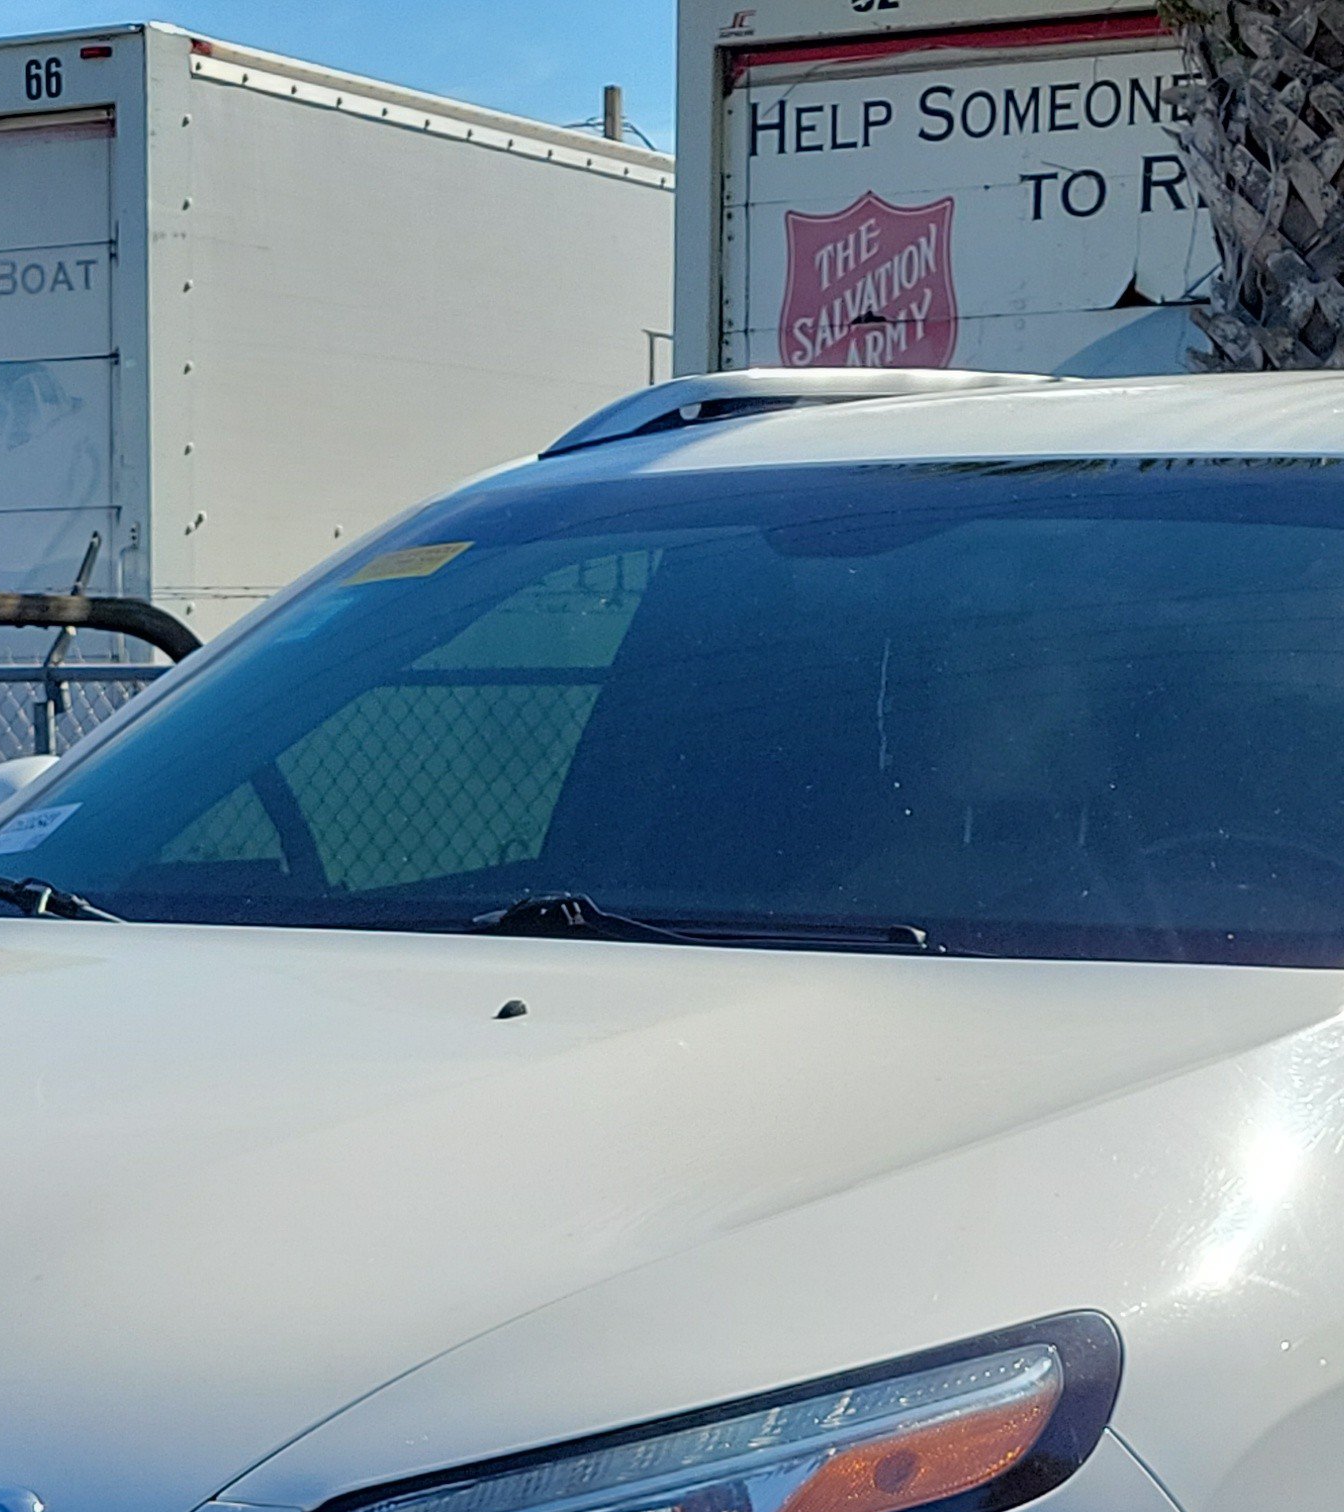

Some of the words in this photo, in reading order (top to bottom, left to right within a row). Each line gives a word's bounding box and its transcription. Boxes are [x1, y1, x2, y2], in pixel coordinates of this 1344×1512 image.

[25, 58, 63, 100] 66
[749, 99, 893, 157] HELP
[1019, 169, 1106, 220] TO
[814, 218, 881, 290] THE
[791, 223, 938, 366] SALVATION
[846, 288, 932, 367] ARMY
